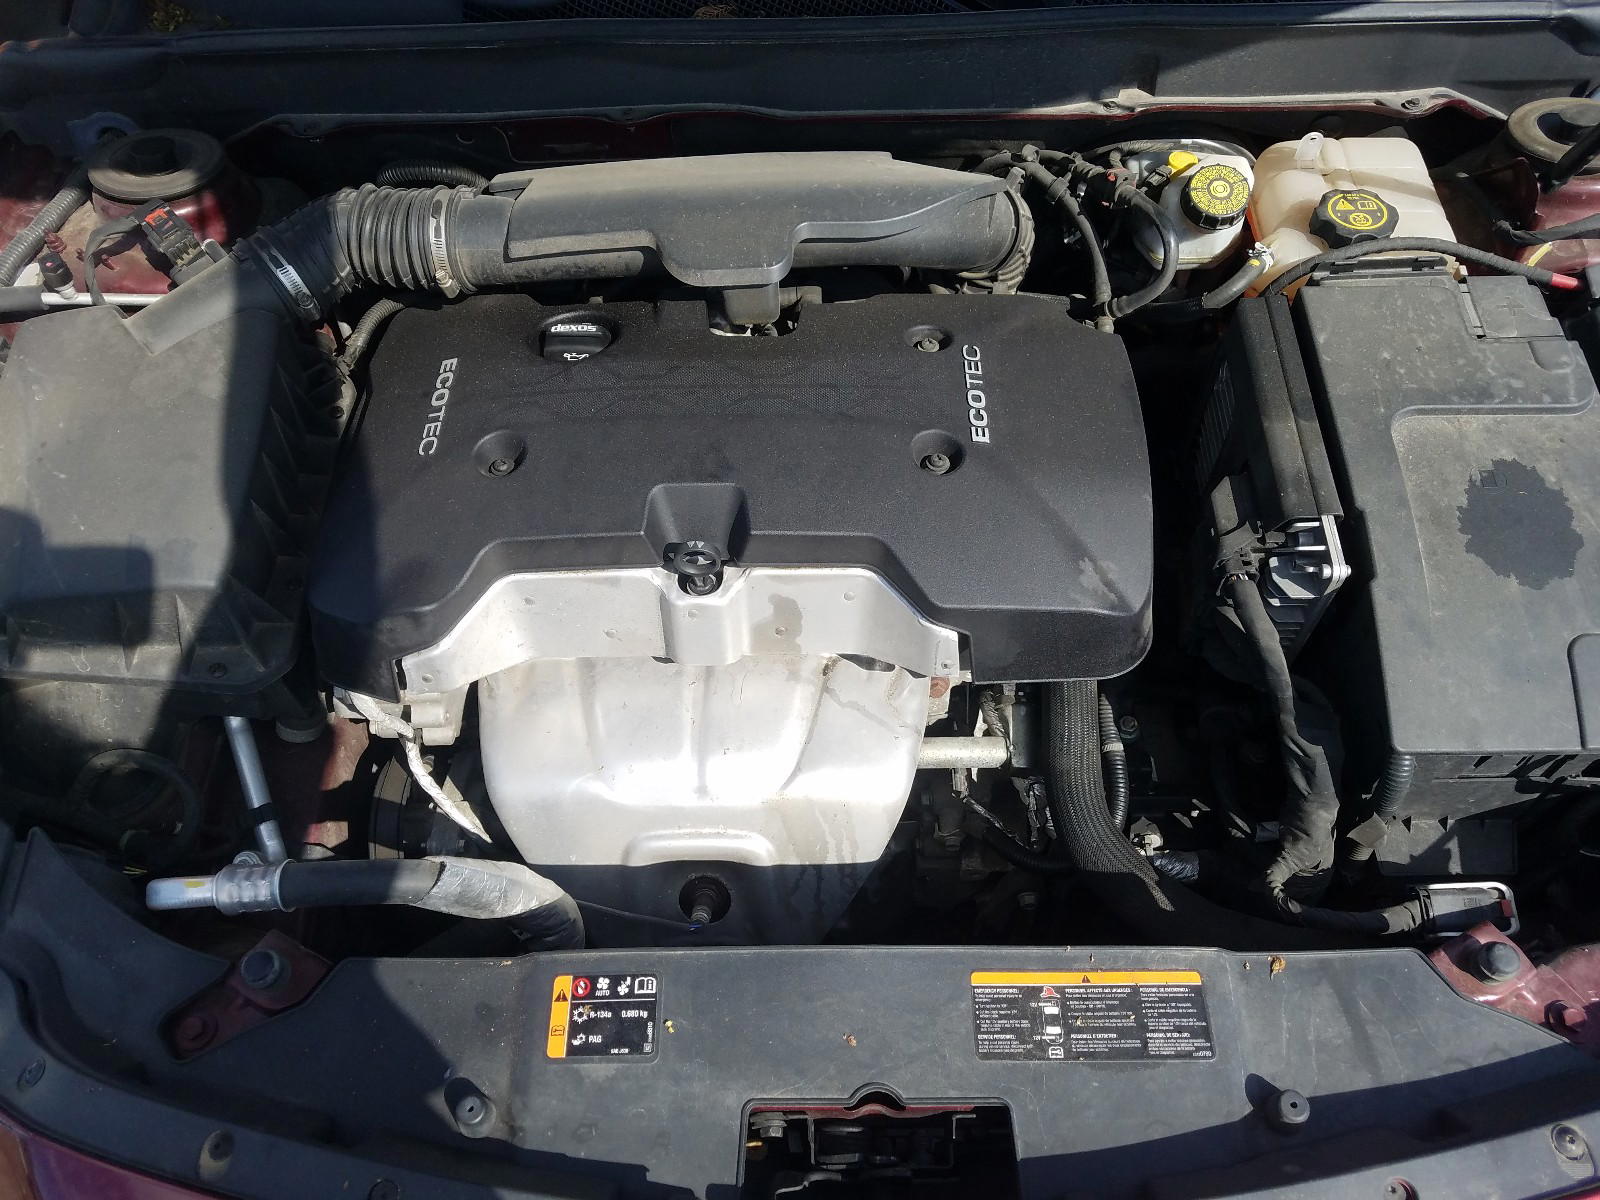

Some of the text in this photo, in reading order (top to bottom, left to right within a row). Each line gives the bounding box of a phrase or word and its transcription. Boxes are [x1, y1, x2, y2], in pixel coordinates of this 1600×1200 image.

[550, 323, 597, 333] dexos
[962, 344, 991, 444] ECOTEC
[418, 357, 458, 456] ECOTEC
[640, 1010, 648, 1018] kg
[588, 1035, 602, 1043] PAG
